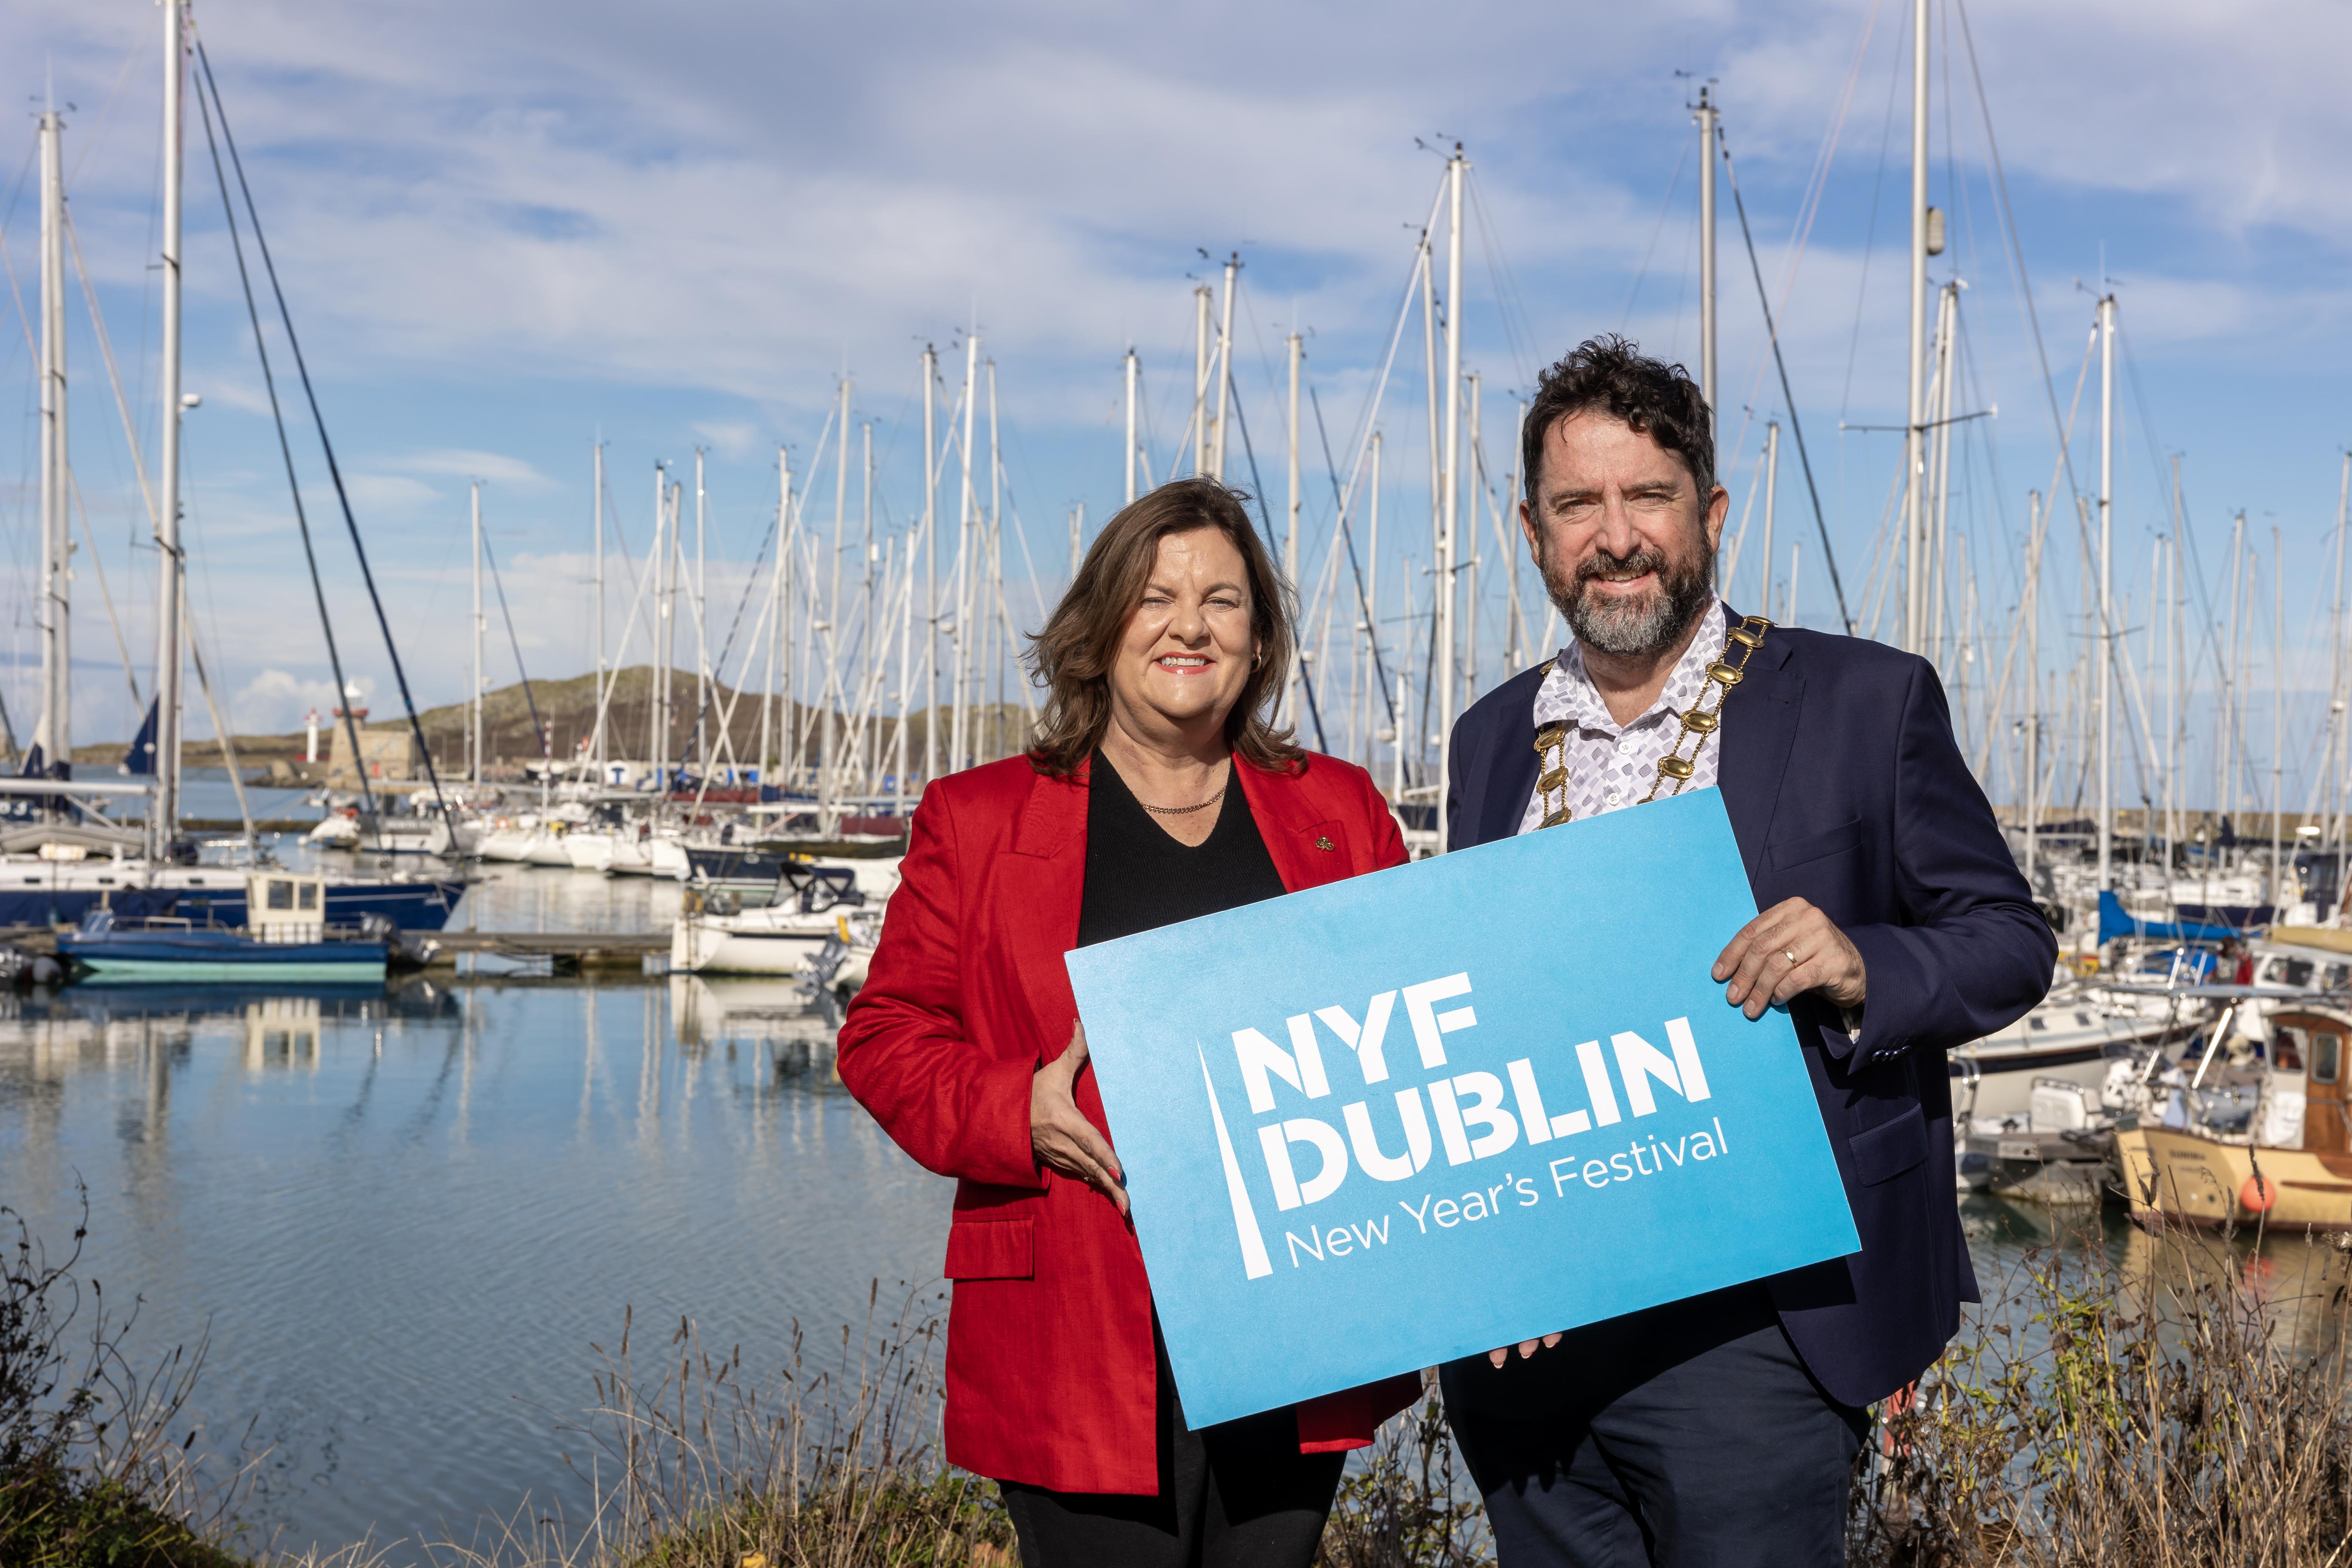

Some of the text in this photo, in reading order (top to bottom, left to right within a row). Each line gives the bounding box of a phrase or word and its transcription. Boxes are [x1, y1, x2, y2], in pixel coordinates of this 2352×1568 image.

[1231, 971, 1478, 1115] NYF
[1257, 1016, 1712, 1212] DUBLIN
[1285, 1117, 1728, 1268] New Year's Festival
